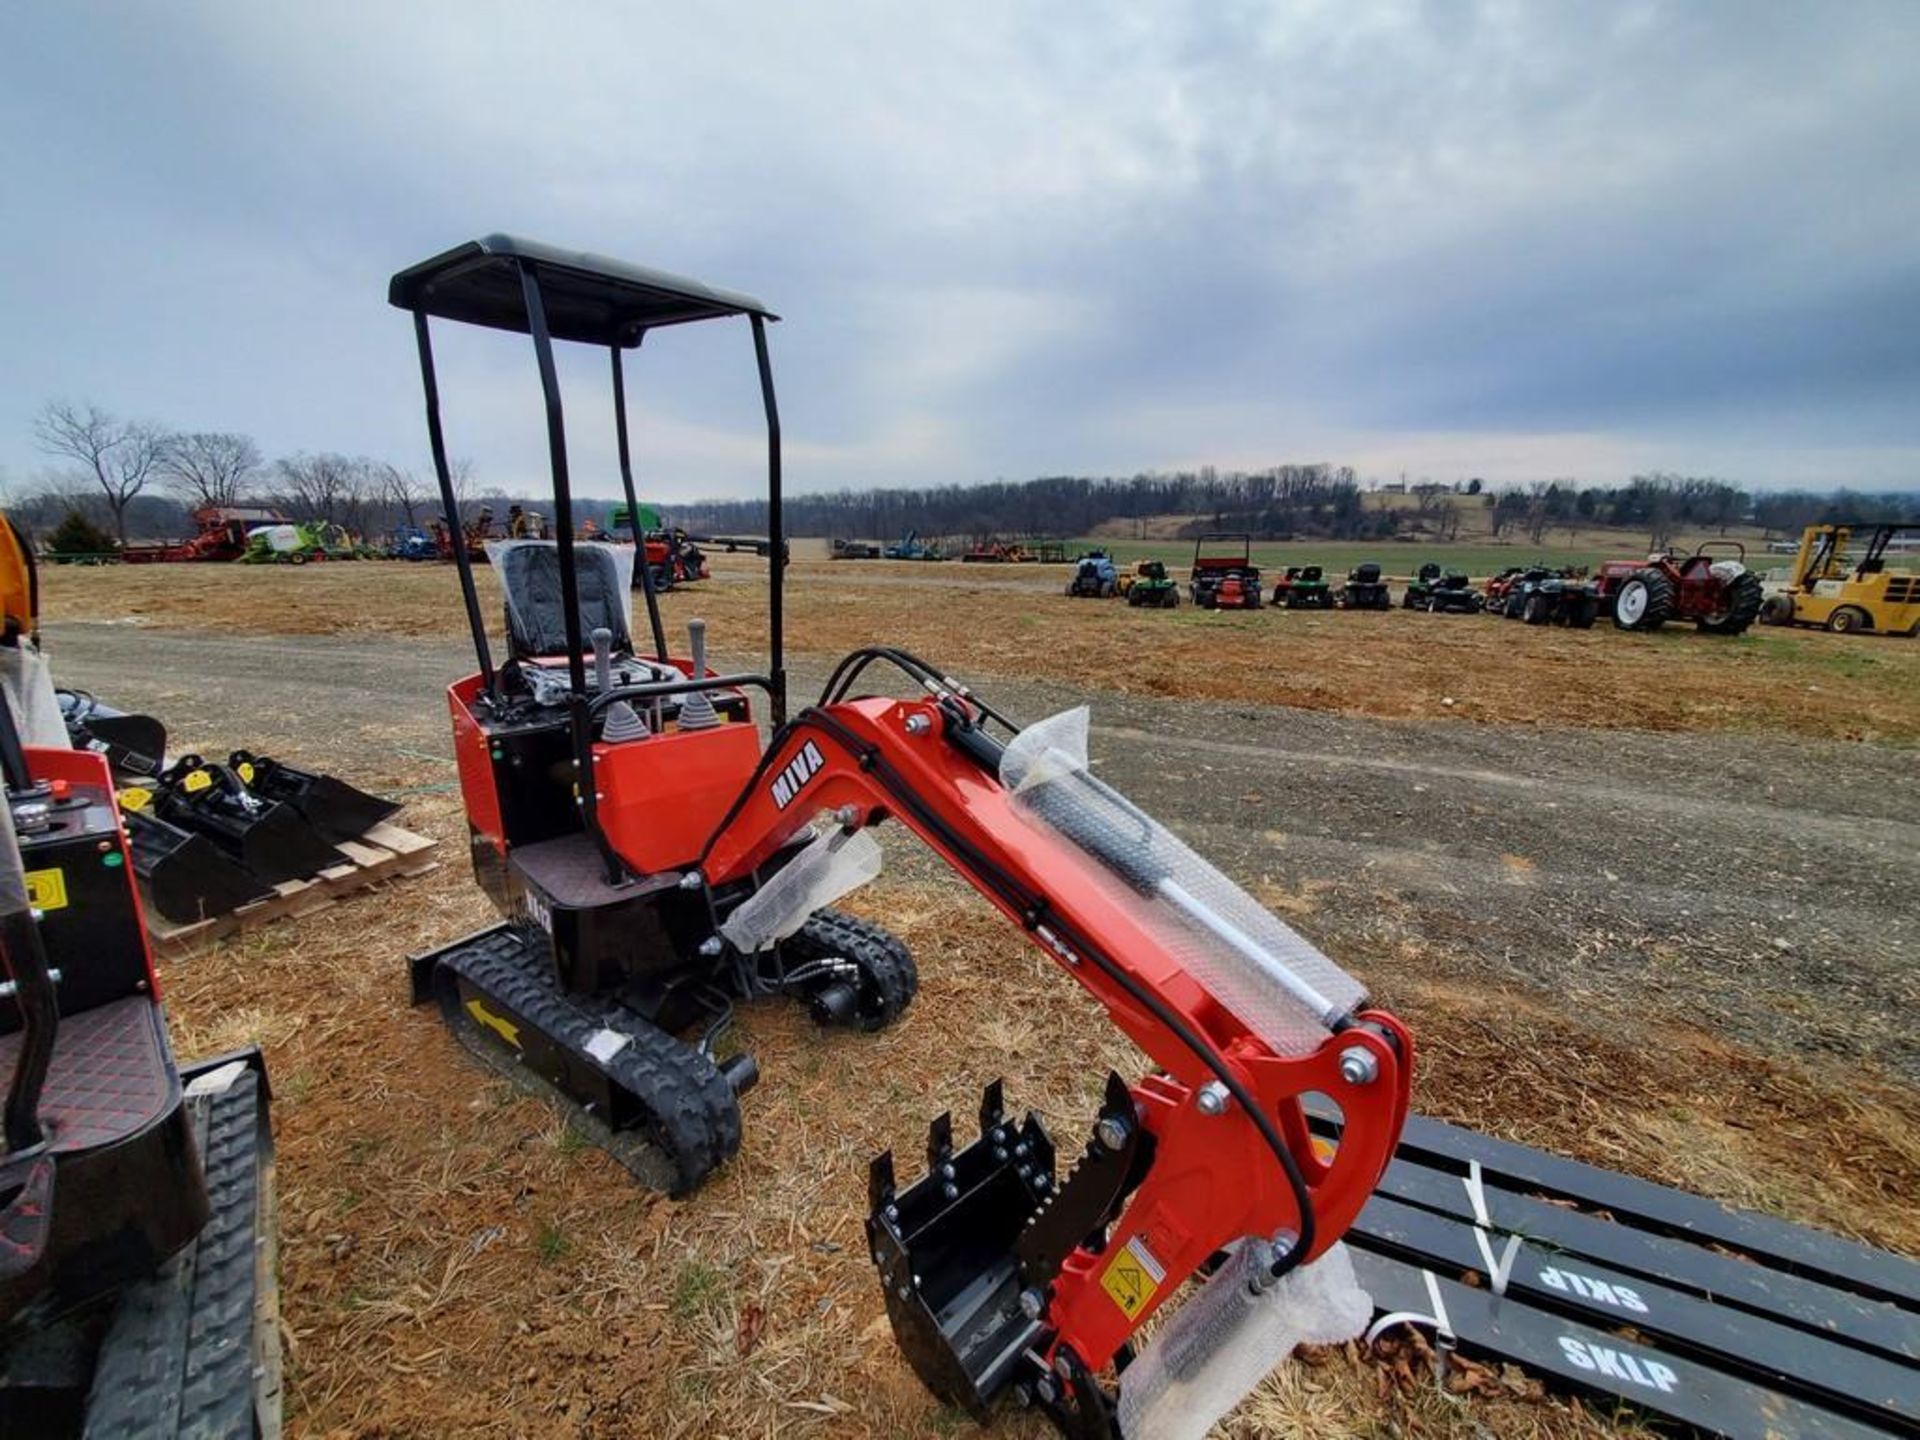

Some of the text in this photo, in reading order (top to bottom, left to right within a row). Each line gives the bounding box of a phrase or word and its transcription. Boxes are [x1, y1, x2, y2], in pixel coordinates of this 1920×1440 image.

[770, 740, 824, 809] MIVA
[1538, 1265, 1649, 1313] SKLP
[1557, 1336, 1678, 1393] SKLP
